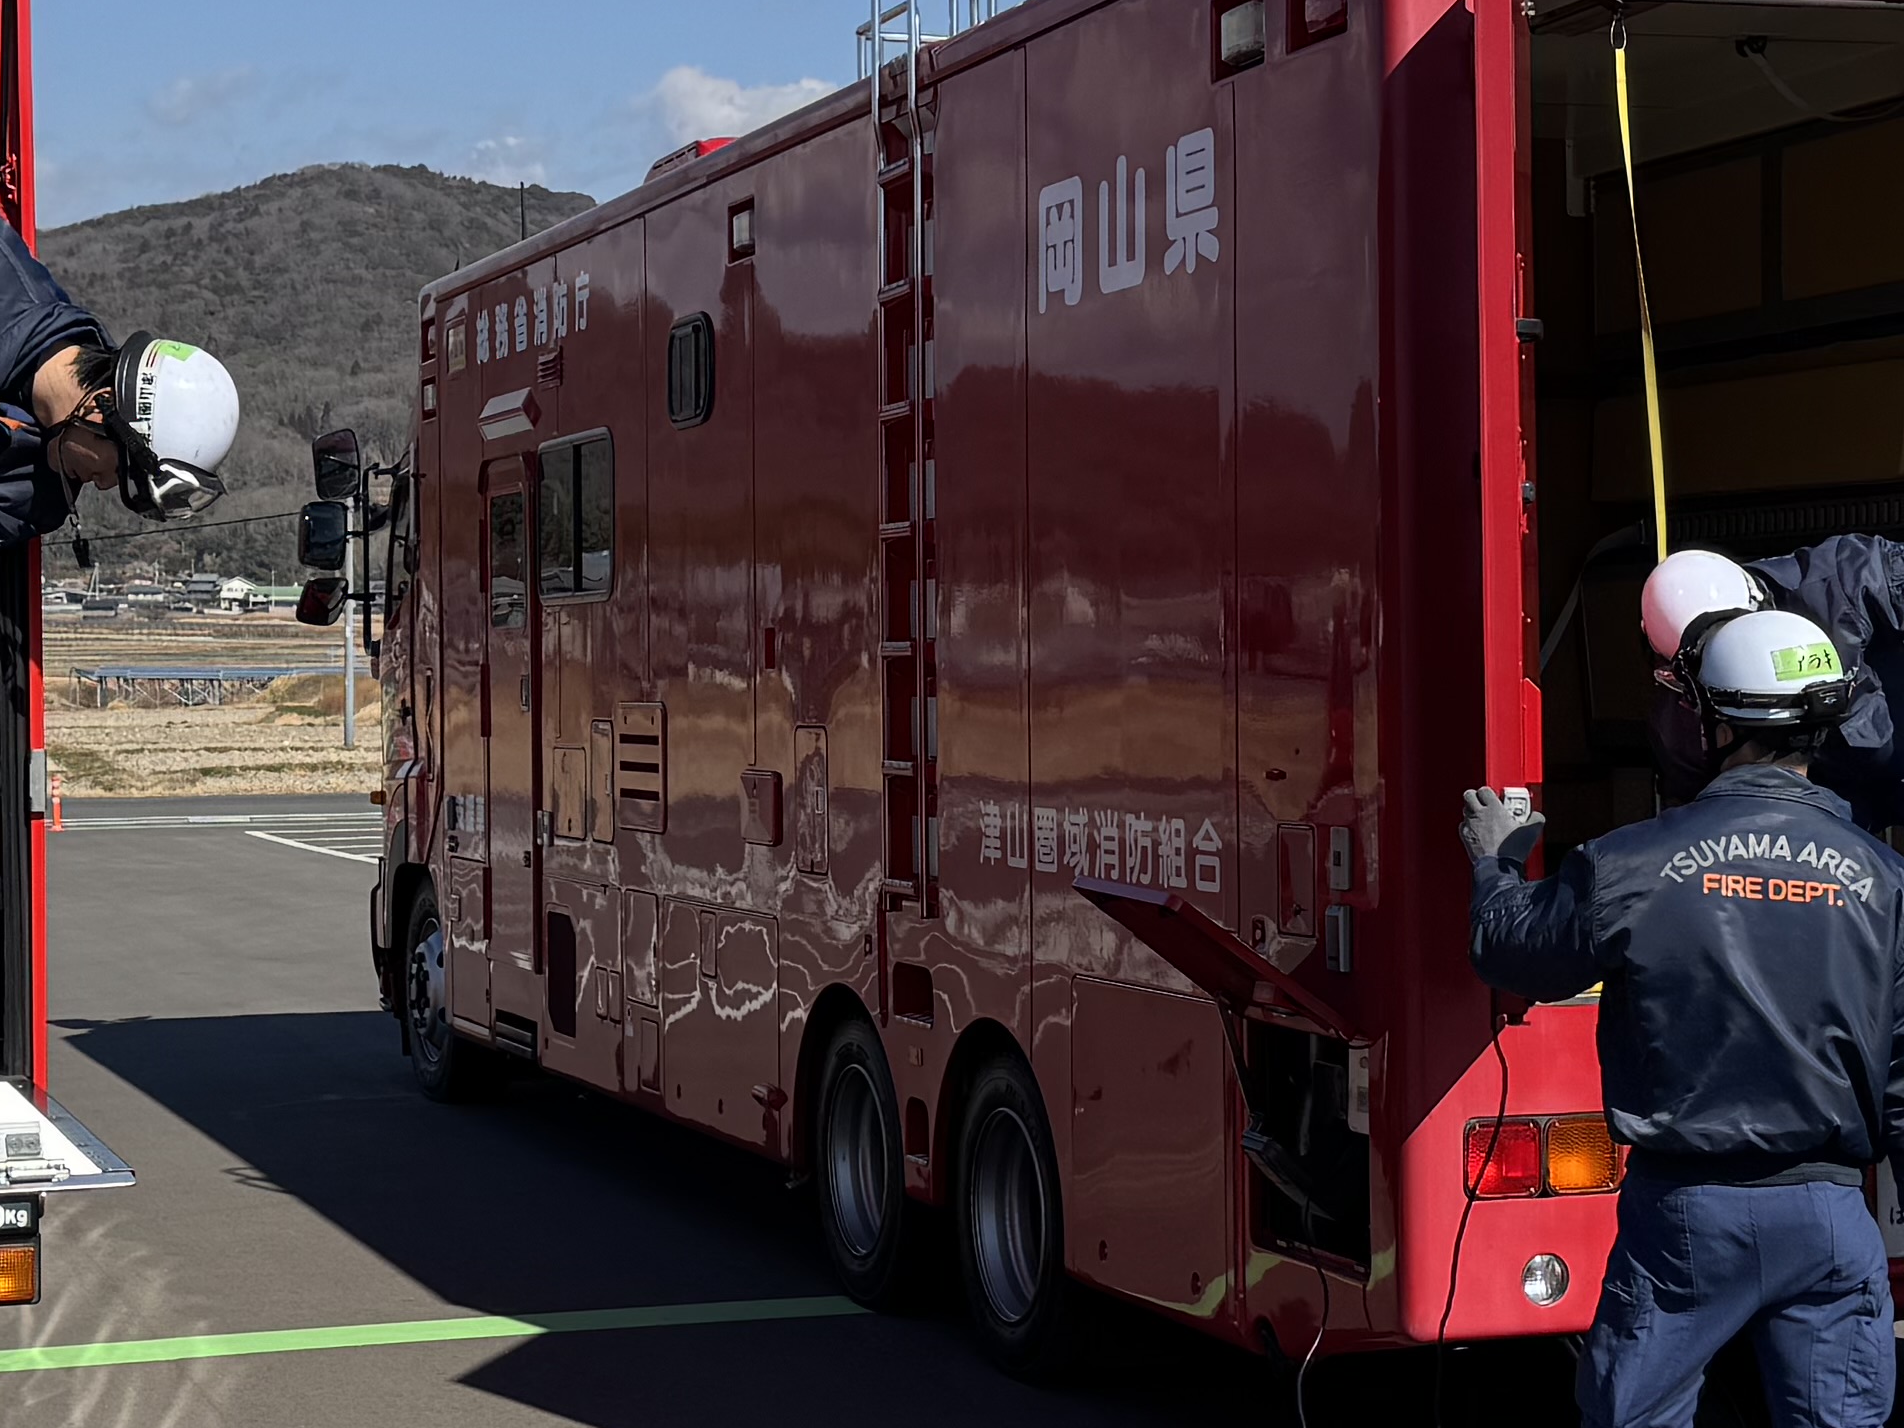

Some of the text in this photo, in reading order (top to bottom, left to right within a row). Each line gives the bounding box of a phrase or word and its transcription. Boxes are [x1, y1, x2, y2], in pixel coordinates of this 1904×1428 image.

[1036, 126, 1222, 314] 岡山県
[475, 269, 590, 365] 総務省消防庁
[980, 799, 1222, 893] 津山圏域消防組合
[1659, 833, 1876, 903] TSUYAMA AREA
[1702, 873, 1845, 907] FIRE DEPT.
